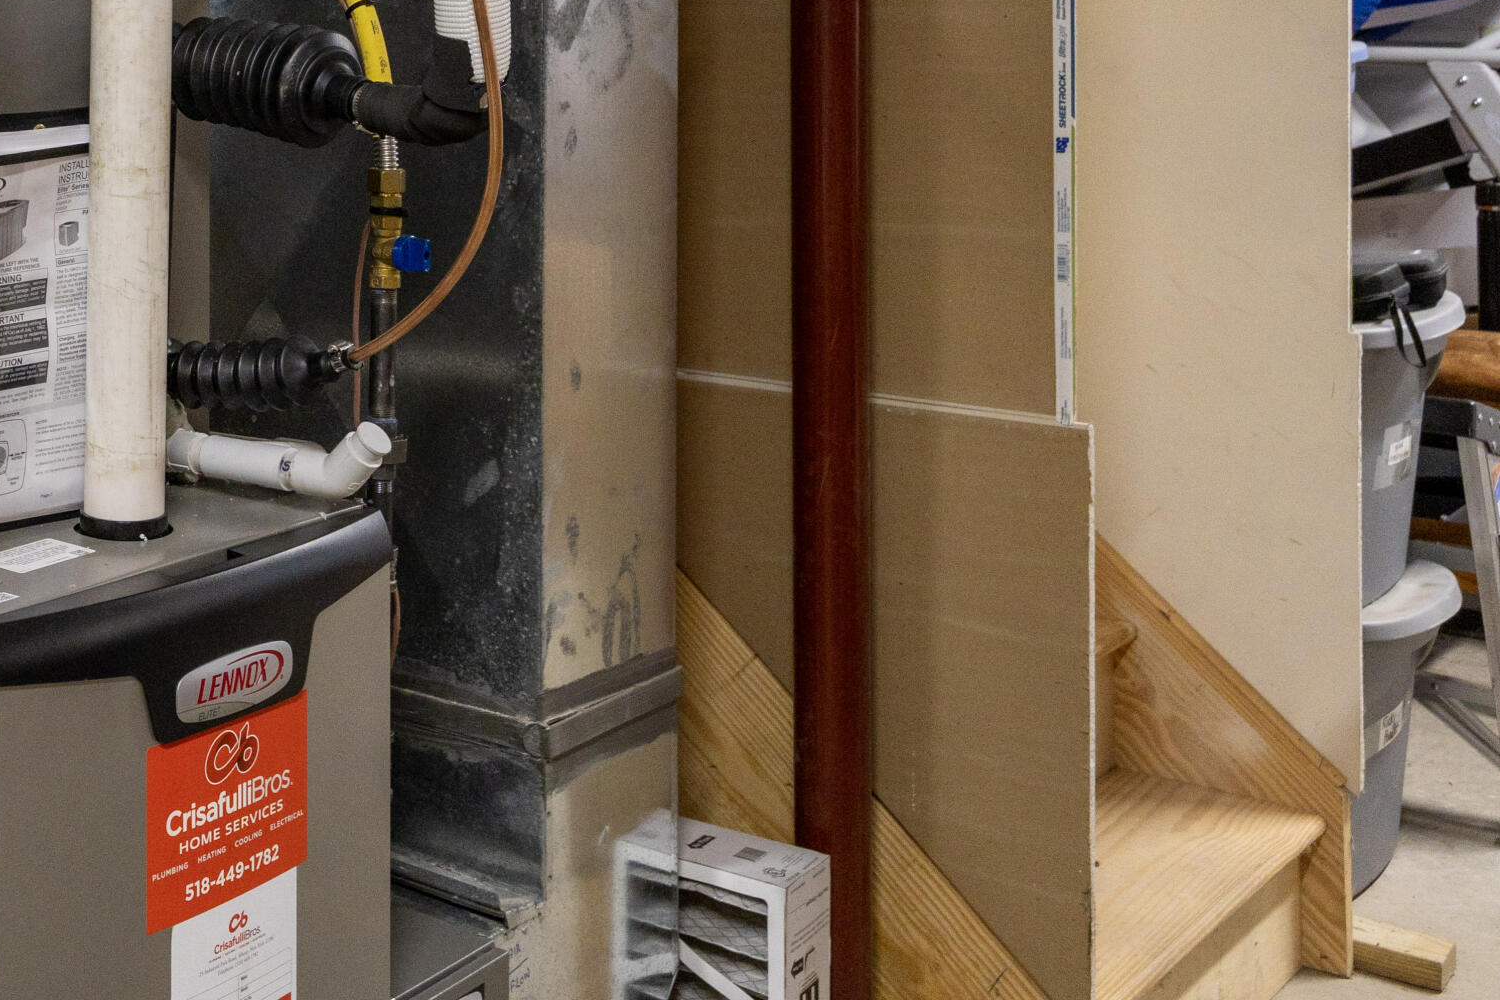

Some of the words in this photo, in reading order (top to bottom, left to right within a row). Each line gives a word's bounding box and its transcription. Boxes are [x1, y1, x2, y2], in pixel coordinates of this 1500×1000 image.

[1058, 73, 1067, 129] SHEETROCK
[197, 657, 268, 705] LENNOX
[152, 862, 189, 882] PLUMBING
[198, 846, 227, 864] HEATING
[235, 829, 263, 848] COOLING
[269, 809, 304, 831] ELECTRICAL
[179, 827, 220, 855] HOME
[225, 799, 284, 836] SERVICES
[186, 843, 280, 901] 518-449-1782
